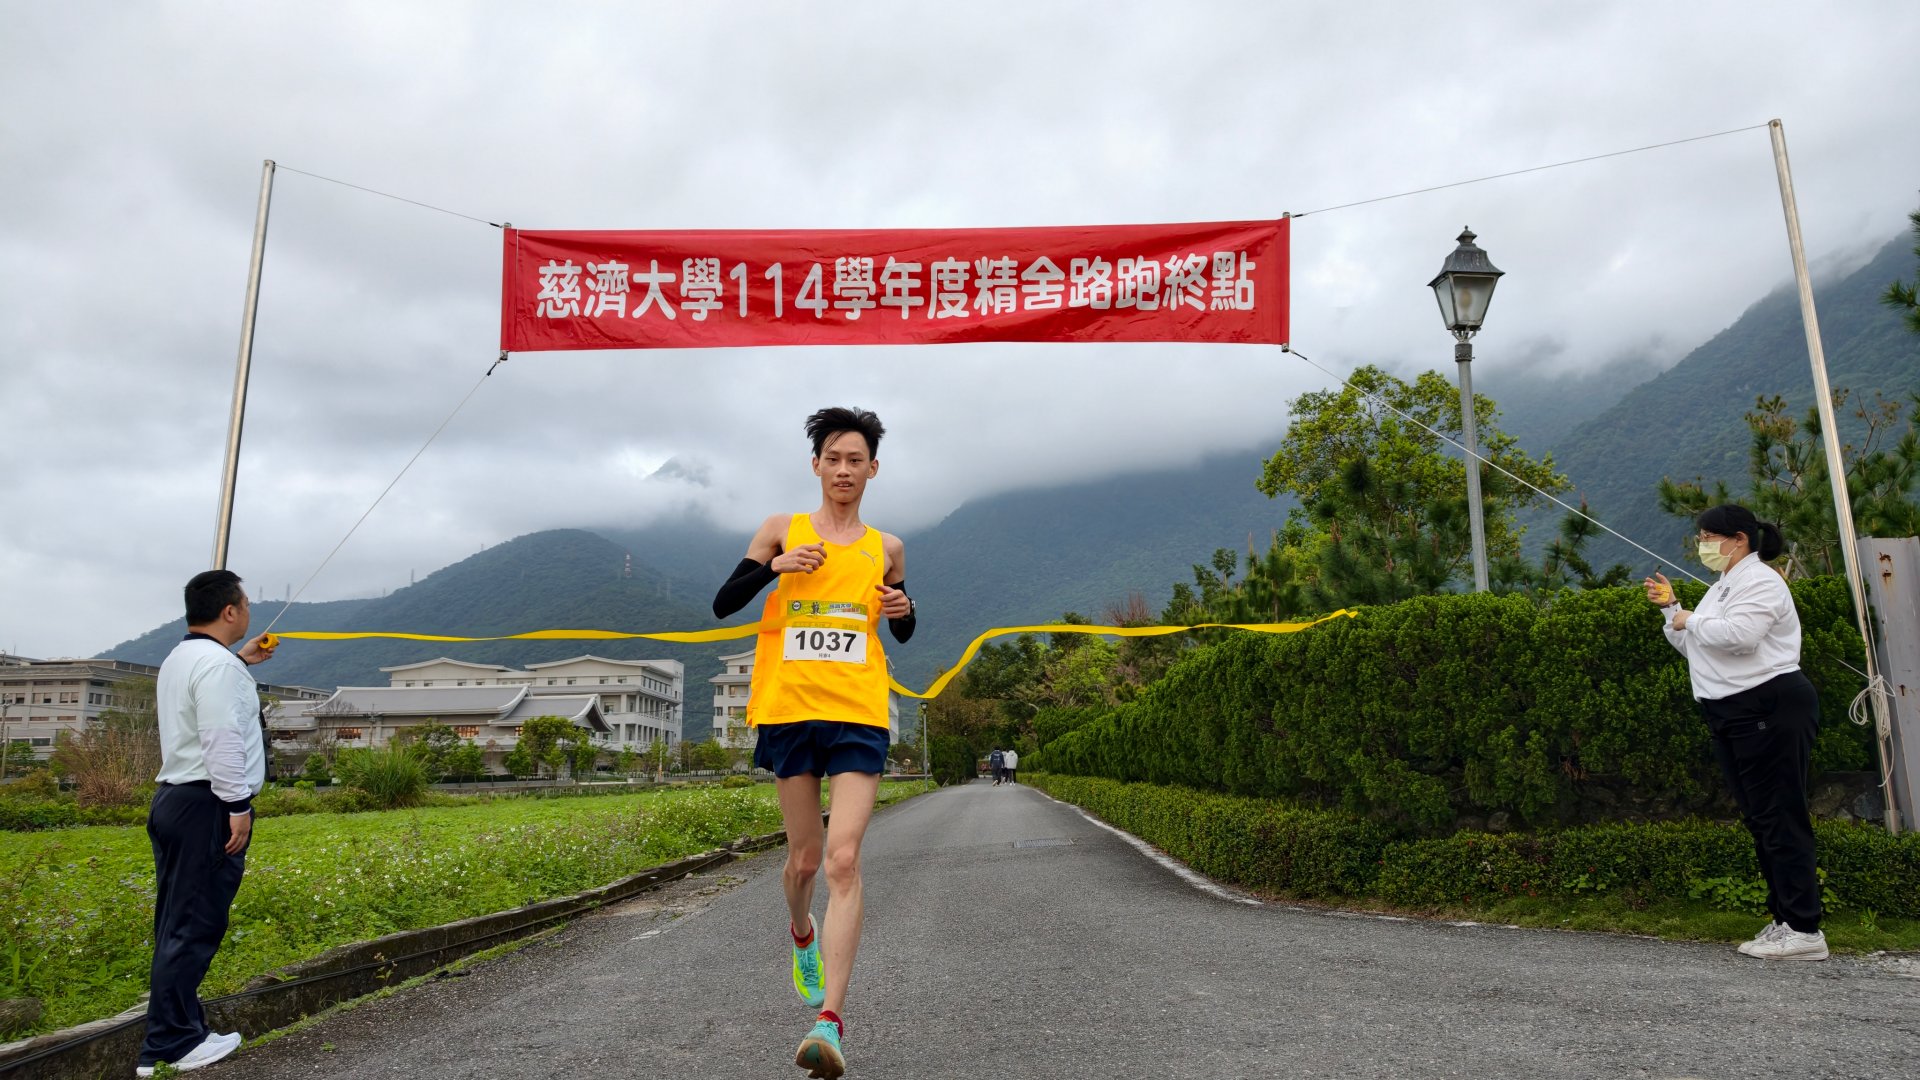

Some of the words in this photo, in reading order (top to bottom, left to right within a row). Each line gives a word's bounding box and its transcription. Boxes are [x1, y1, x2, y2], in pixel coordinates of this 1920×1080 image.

[536, 251, 1256, 321] 慈濟大學114學年度精舍路跑終點
[795, 630, 857, 653] 1037
